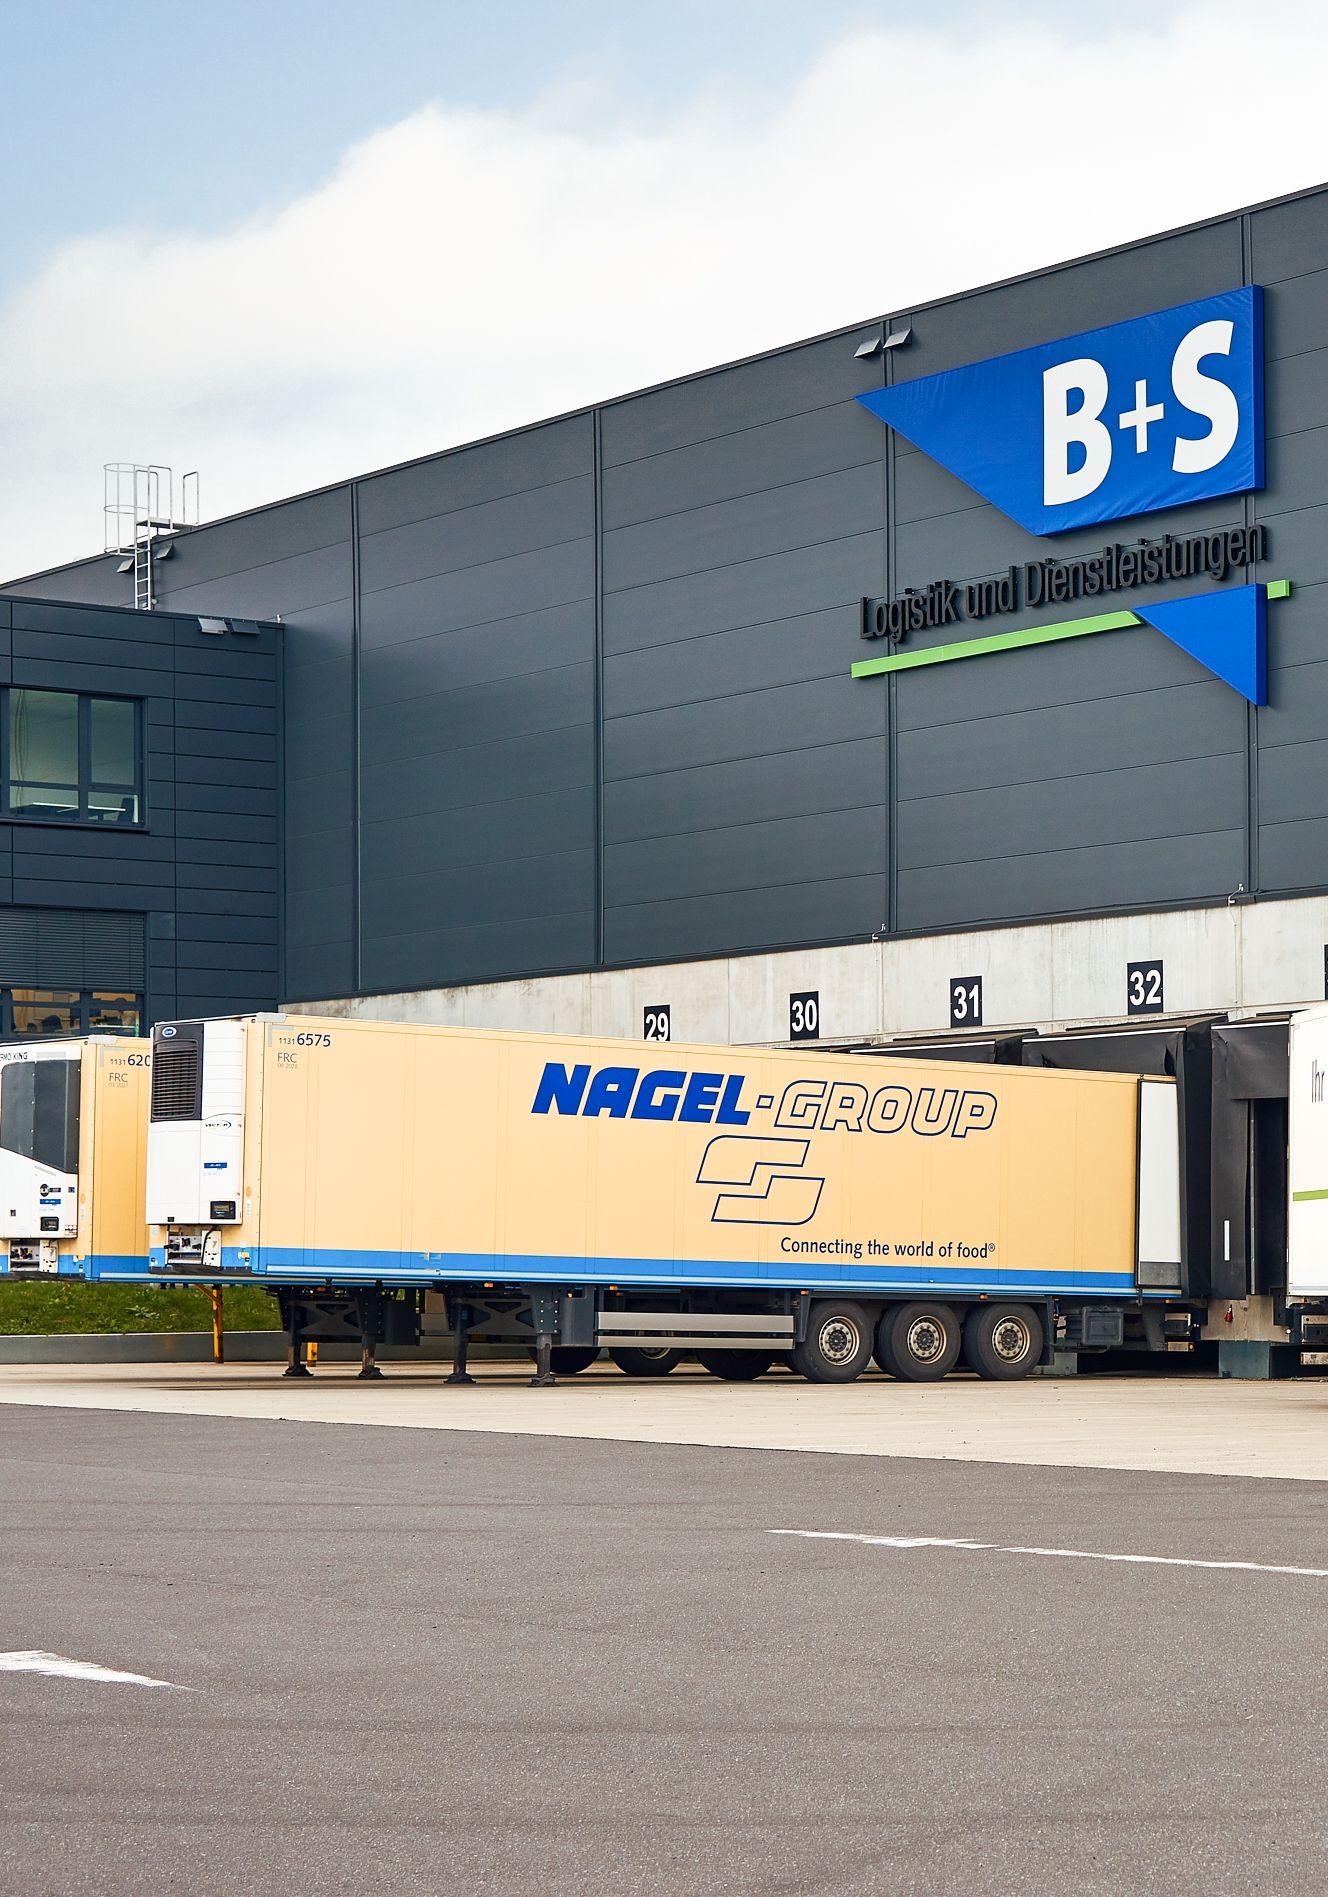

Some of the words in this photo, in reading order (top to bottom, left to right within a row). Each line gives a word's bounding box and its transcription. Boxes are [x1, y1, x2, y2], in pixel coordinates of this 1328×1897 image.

[1042, 319, 1240, 507] B+S
[859, 579, 960, 644] Logistik
[965, 565, 1018, 618] und
[1023, 523, 1268, 607] Dienstleistungen
[953, 984, 980, 1019] 31
[1129, 969, 1162, 1006] 32
[645, 1013, 669, 1041] 29
[791, 999, 818, 1033] 30
[296, 1032, 331, 1047] 6575
[277, 1052, 298, 1063] FRC
[109, 1072, 128, 1083] FRC
[1311, 1058, 1325, 1103] Ihr
[531, 1062, 998, 1138] NAGEL-GROUP
[780, 1236, 864, 1259] Connecting
[867, 1239, 890, 1256] the
[894, 1240, 934, 1257] world
[938, 1241, 953, 1258] of
